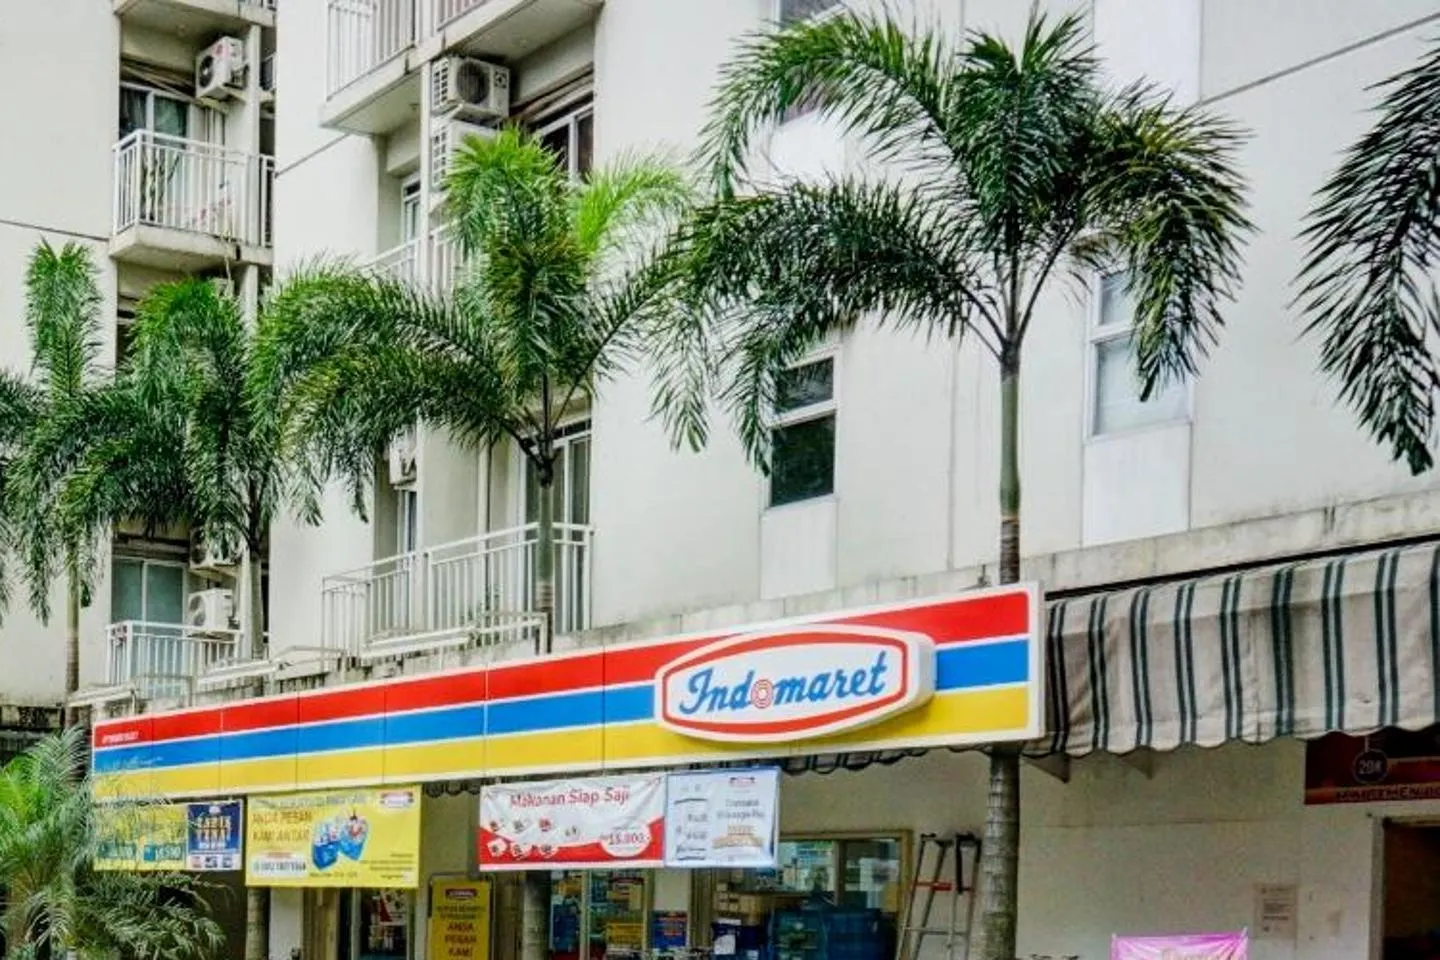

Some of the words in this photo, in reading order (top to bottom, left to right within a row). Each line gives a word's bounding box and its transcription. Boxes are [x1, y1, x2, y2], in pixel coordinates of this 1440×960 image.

[679, 650, 888, 715] Indomaret
[510, 791, 565, 808] Makanan
[569, 787, 600, 807] Siap
[604, 785, 630, 805] Saji
